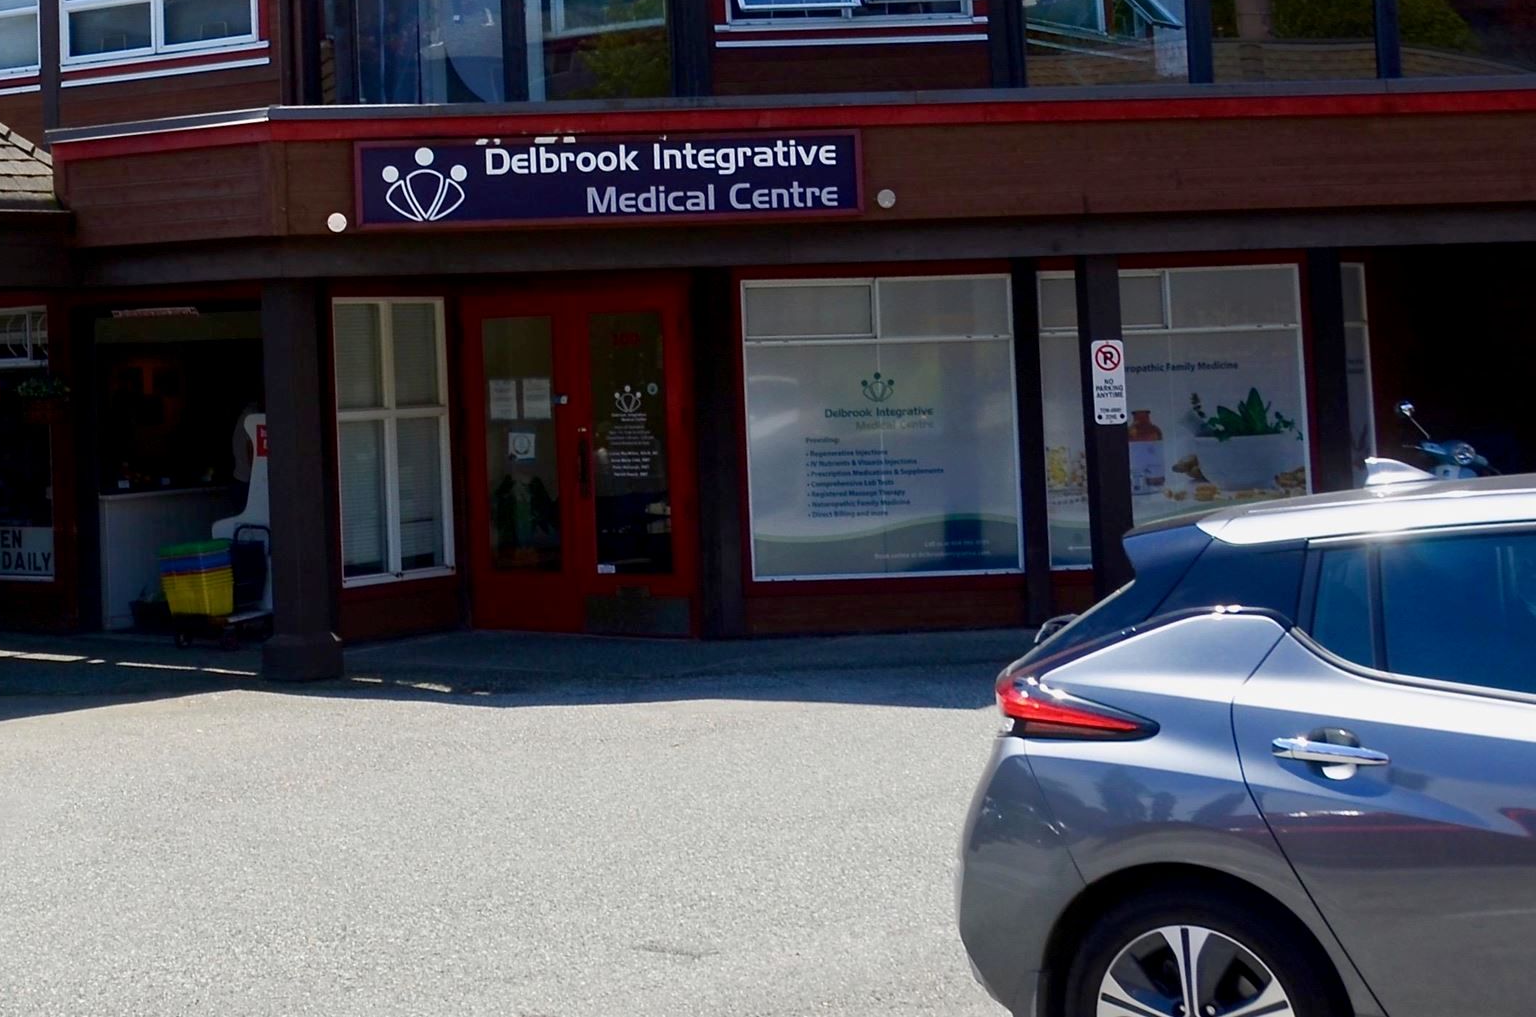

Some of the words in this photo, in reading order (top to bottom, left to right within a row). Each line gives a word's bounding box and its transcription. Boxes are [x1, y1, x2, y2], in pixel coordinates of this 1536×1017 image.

[485, 144, 640, 175] Delbrook
[653, 139, 837, 175] Integrative
[586, 184, 715, 214] Medical
[729, 181, 839, 210] Centre
[1166, 361, 1195, 373] Family
[1198, 360, 1239, 371] Medicine
[1095, 384, 1124, 392] PARKING
[1096, 391, 1124, 399] ANYTIME
[824, 407, 872, 418] Delbrook
[876, 406, 934, 419] Integrative
[2, 551, 51, 571] DAILY
